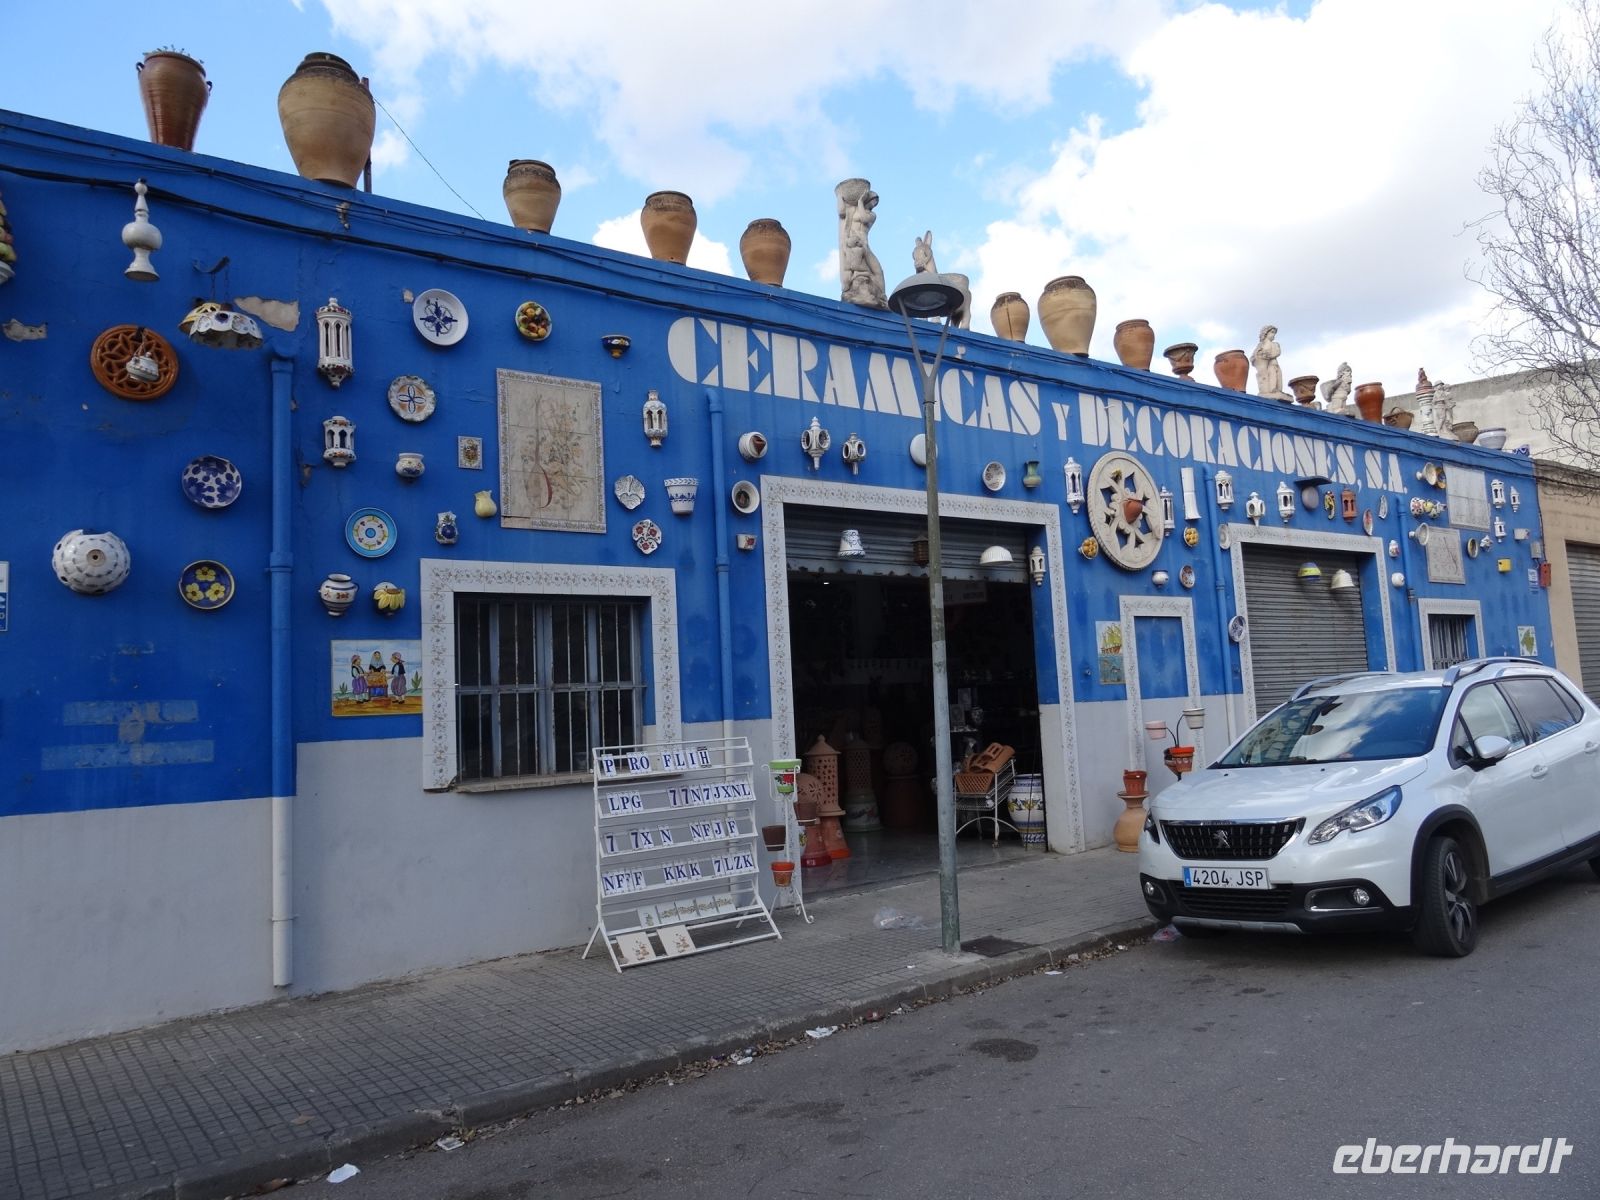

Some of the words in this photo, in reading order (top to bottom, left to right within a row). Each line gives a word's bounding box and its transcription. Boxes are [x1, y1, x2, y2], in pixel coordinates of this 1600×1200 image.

[1364, 449, 1408, 495] S.A.
[608, 794, 642, 811] LPG
[1193, 869, 1230, 886] 4204
[1236, 871, 1264, 887] JSP
